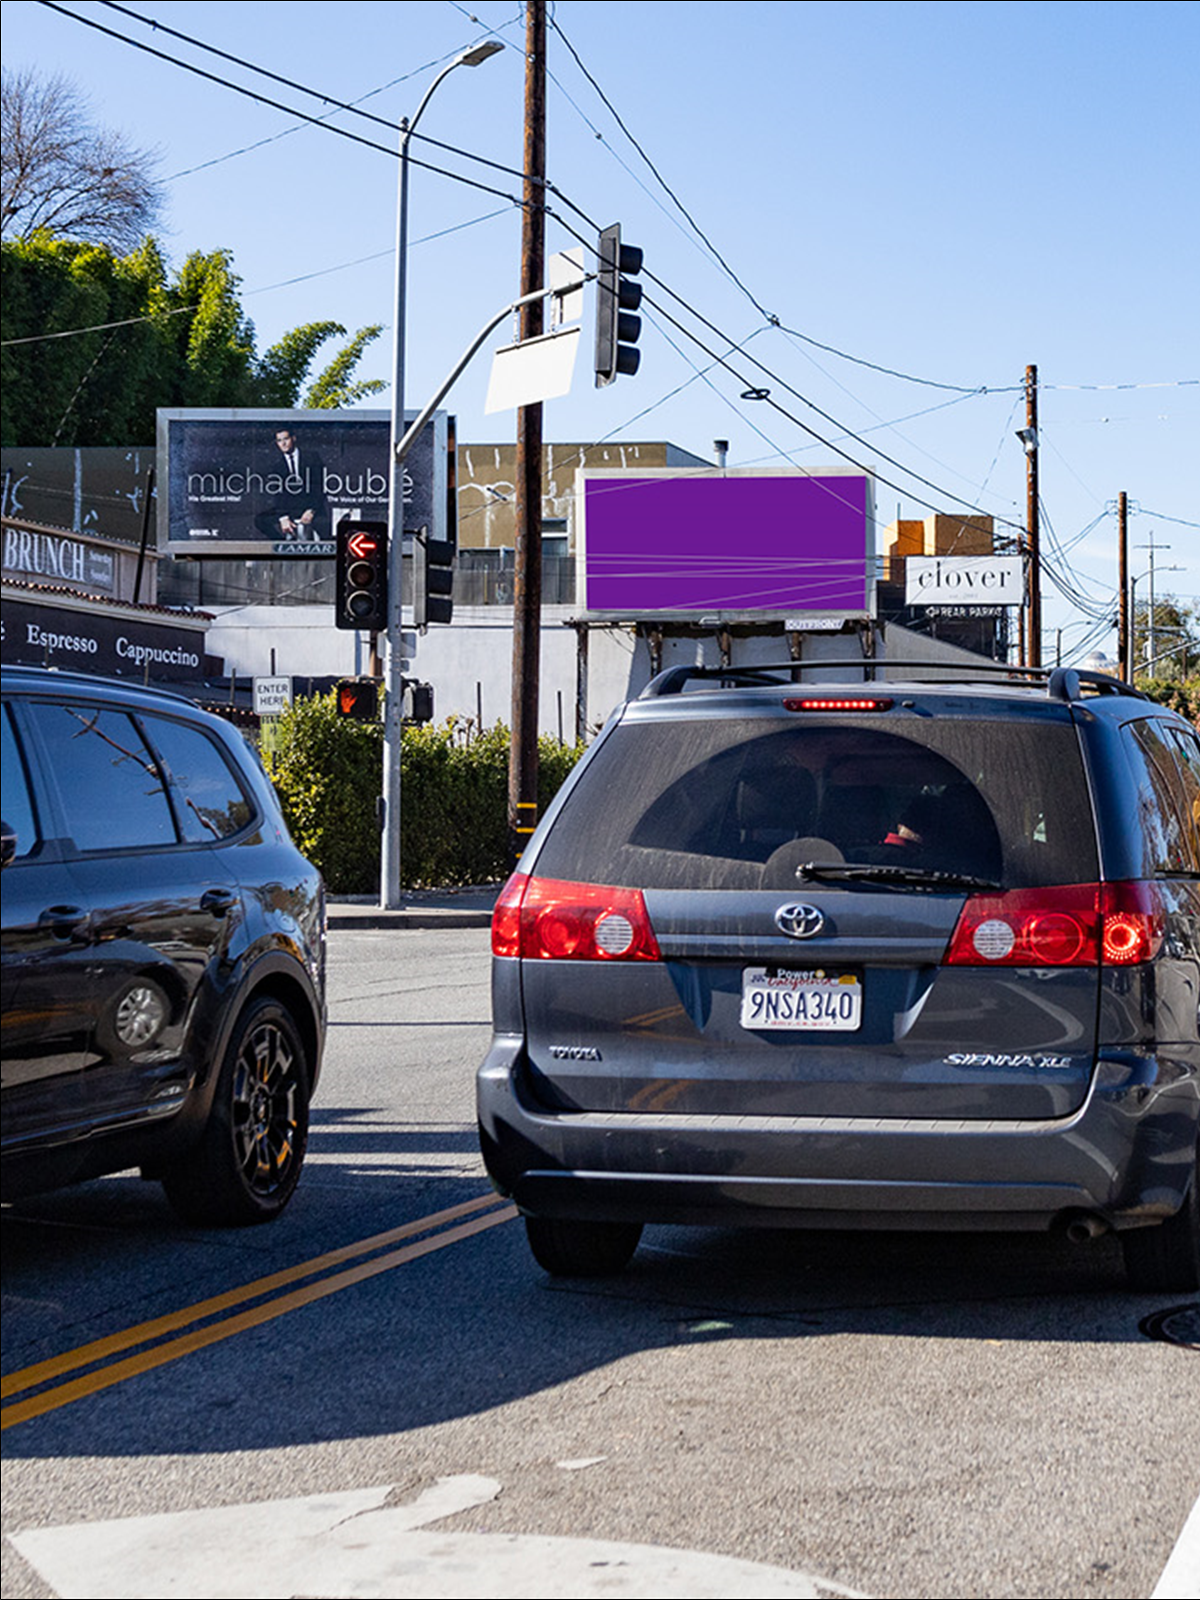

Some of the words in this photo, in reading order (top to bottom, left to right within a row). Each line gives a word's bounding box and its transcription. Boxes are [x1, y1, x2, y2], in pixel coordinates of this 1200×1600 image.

[187, 467, 310, 495] michael
[323, 467, 414, 496] bubé
[3, 527, 86, 582] BRUNCH
[918, 561, 1012, 589] clover
[26, 623, 98, 654] Espresso
[115, 636, 200, 667] Cappuccino
[257, 683, 289, 694] ENTER
[777, 968, 815, 981] Power
[751, 991, 853, 1020] 9NSA340
[548, 1045, 603, 1062] TOYOTA
[943, 1053, 1035, 1067] SIENNA
[1039, 1056, 1072, 1068] XLE
